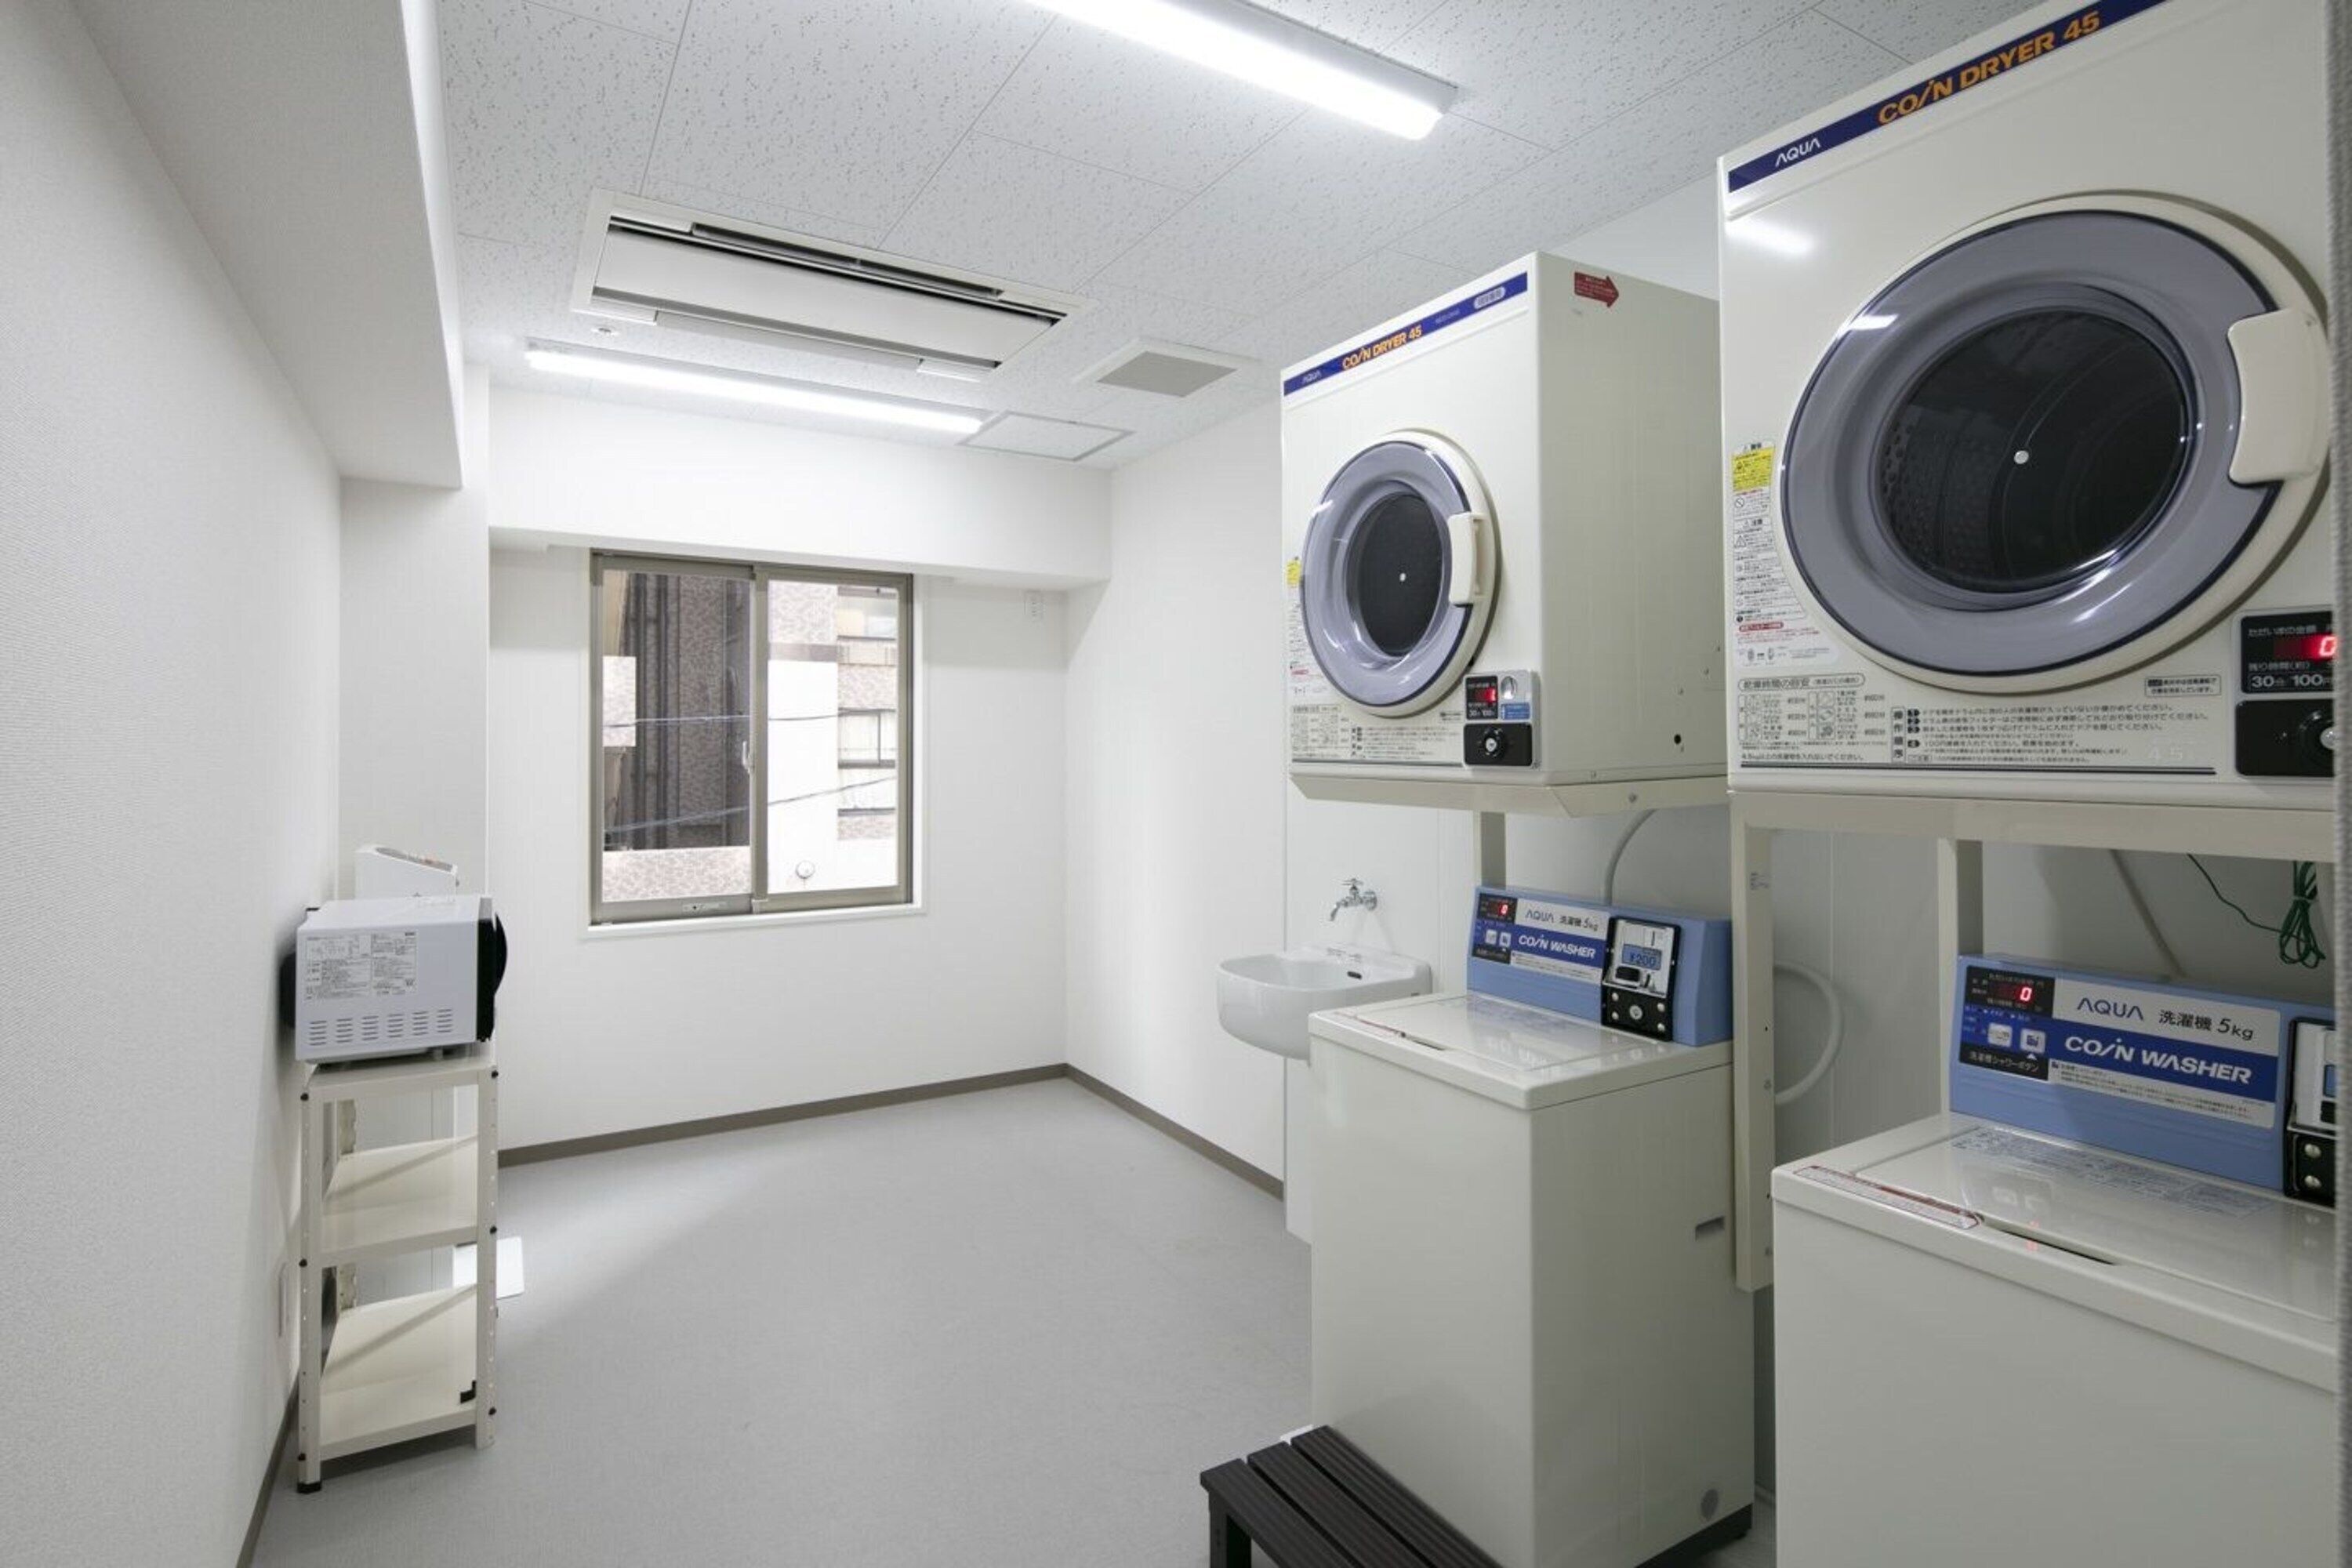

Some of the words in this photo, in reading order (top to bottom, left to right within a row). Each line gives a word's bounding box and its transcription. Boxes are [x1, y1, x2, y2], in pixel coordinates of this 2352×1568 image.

[1775, 136, 1820, 167] AQUA
[1958, 35, 2056, 89] DRYER
[2062, 11, 2101, 43] 45
[1373, 332, 1407, 356] DRYER
[1409, 325, 1422, 339] 45
[1525, 909, 1554, 923] AQUA
[1583, 918, 1599, 931] 5kg
[1550, 940, 1596, 959] WASHER
[2020, 986, 2032, 1003] 0
[2077, 996, 2144, 1022] AQUA
[2159, 1008, 2212, 1033] 洗濯機
[2217, 1018, 2255, 1042] 5kg
[2141, 1051, 2252, 1085] WASHER
